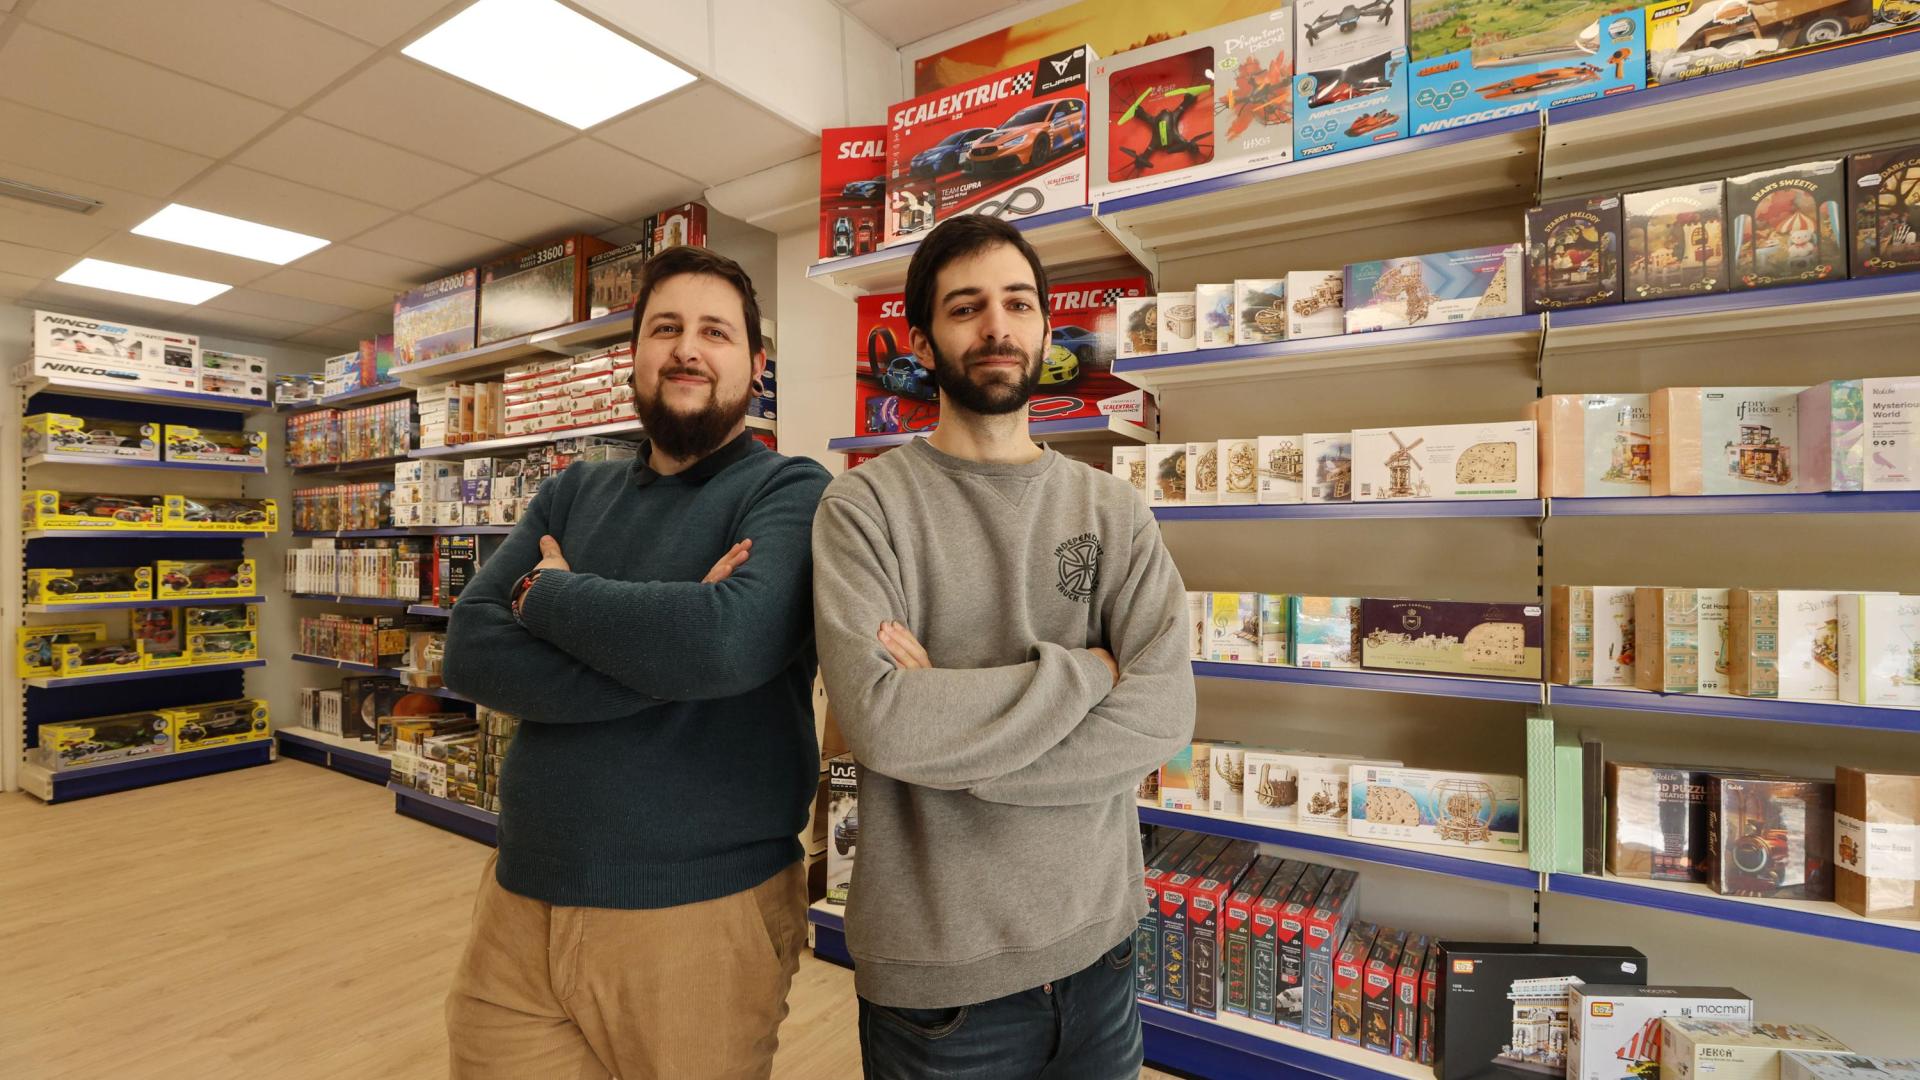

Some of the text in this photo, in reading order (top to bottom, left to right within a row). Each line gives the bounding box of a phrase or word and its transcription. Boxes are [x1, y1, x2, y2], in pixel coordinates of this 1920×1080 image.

[1680, 60, 1740, 78] DUMP TRUCK
[1041, 73, 1081, 90] CUPRA
[892, 77, 1012, 131] SCALEXTRIC
[1308, 95, 1389, 120] NINCOCEAN
[1551, 92, 1598, 106] OFFSHORE
[1415, 101, 1539, 134] NINCOCEAN
[1302, 142, 1337, 156] TREXX
[1880, 161, 1906, 178] DARK
[941, 187, 960, 197] TEAM
[960, 180, 982, 192] CUPRA
[1751, 179, 1819, 201] BEAR'S SWEETIE
[1544, 211, 1601, 233] STARRY MELODY
[536, 245, 564, 264] 33600
[439, 275, 465, 293] 42000
[1736, 401, 1748, 421] if
[1053, 532, 1104, 558] INDEPENDNT
[467, 550, 474, 560] 5
[1055, 582, 1080, 603] TRUCK
[1698, 1047, 1733, 1058] JEKCA
